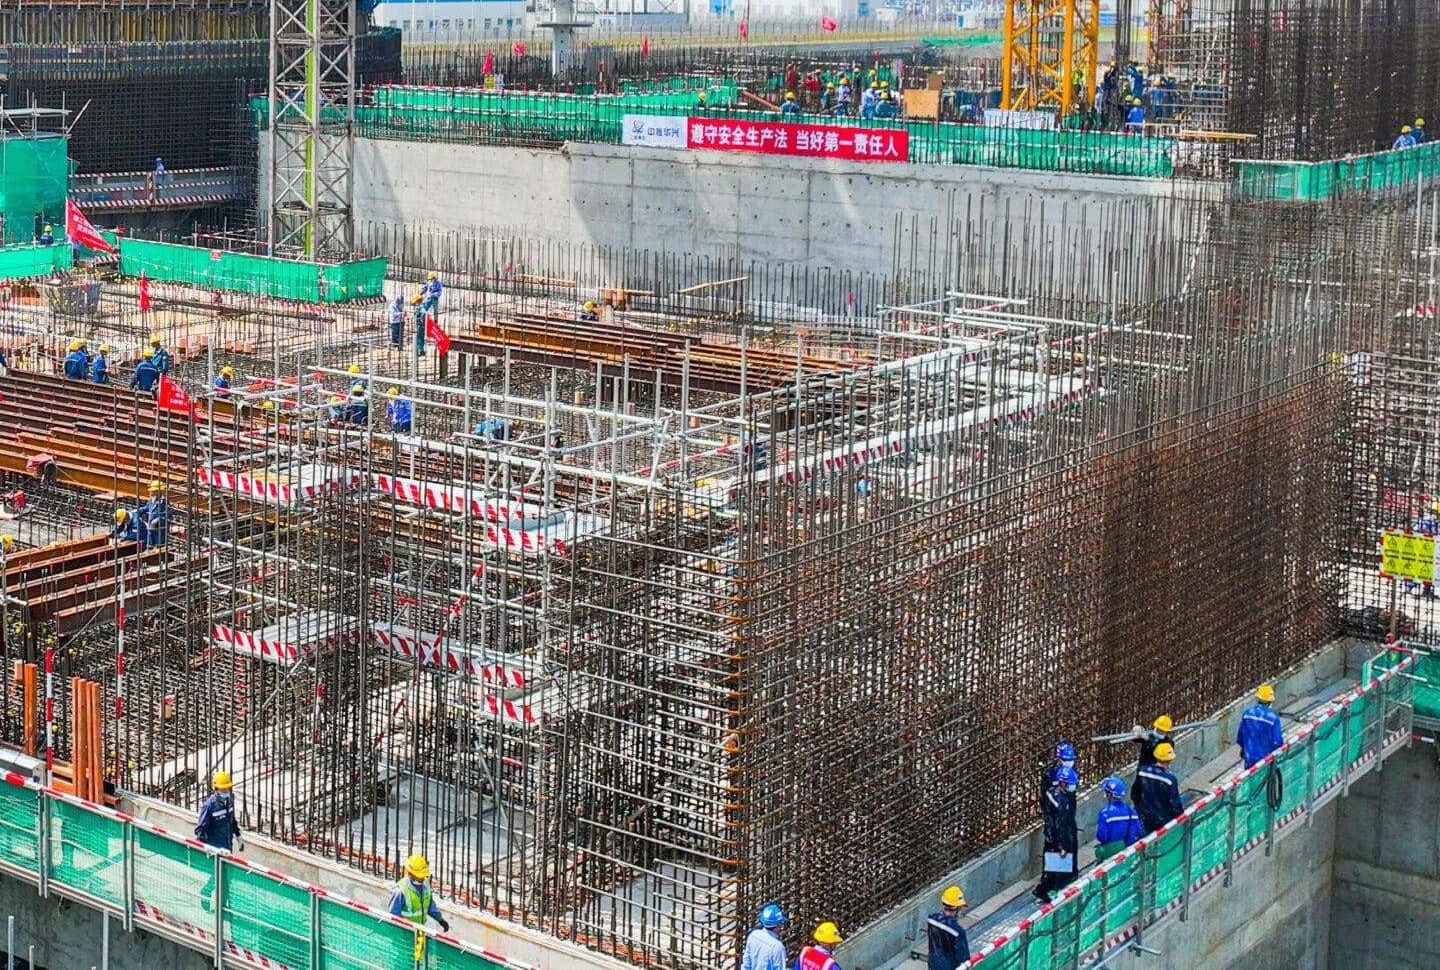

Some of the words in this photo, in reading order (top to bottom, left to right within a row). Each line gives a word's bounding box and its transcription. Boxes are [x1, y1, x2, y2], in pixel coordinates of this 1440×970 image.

[690, 123, 788, 149] 遵守安全生产法
[795, 128, 899, 157] 当好第一责任人
